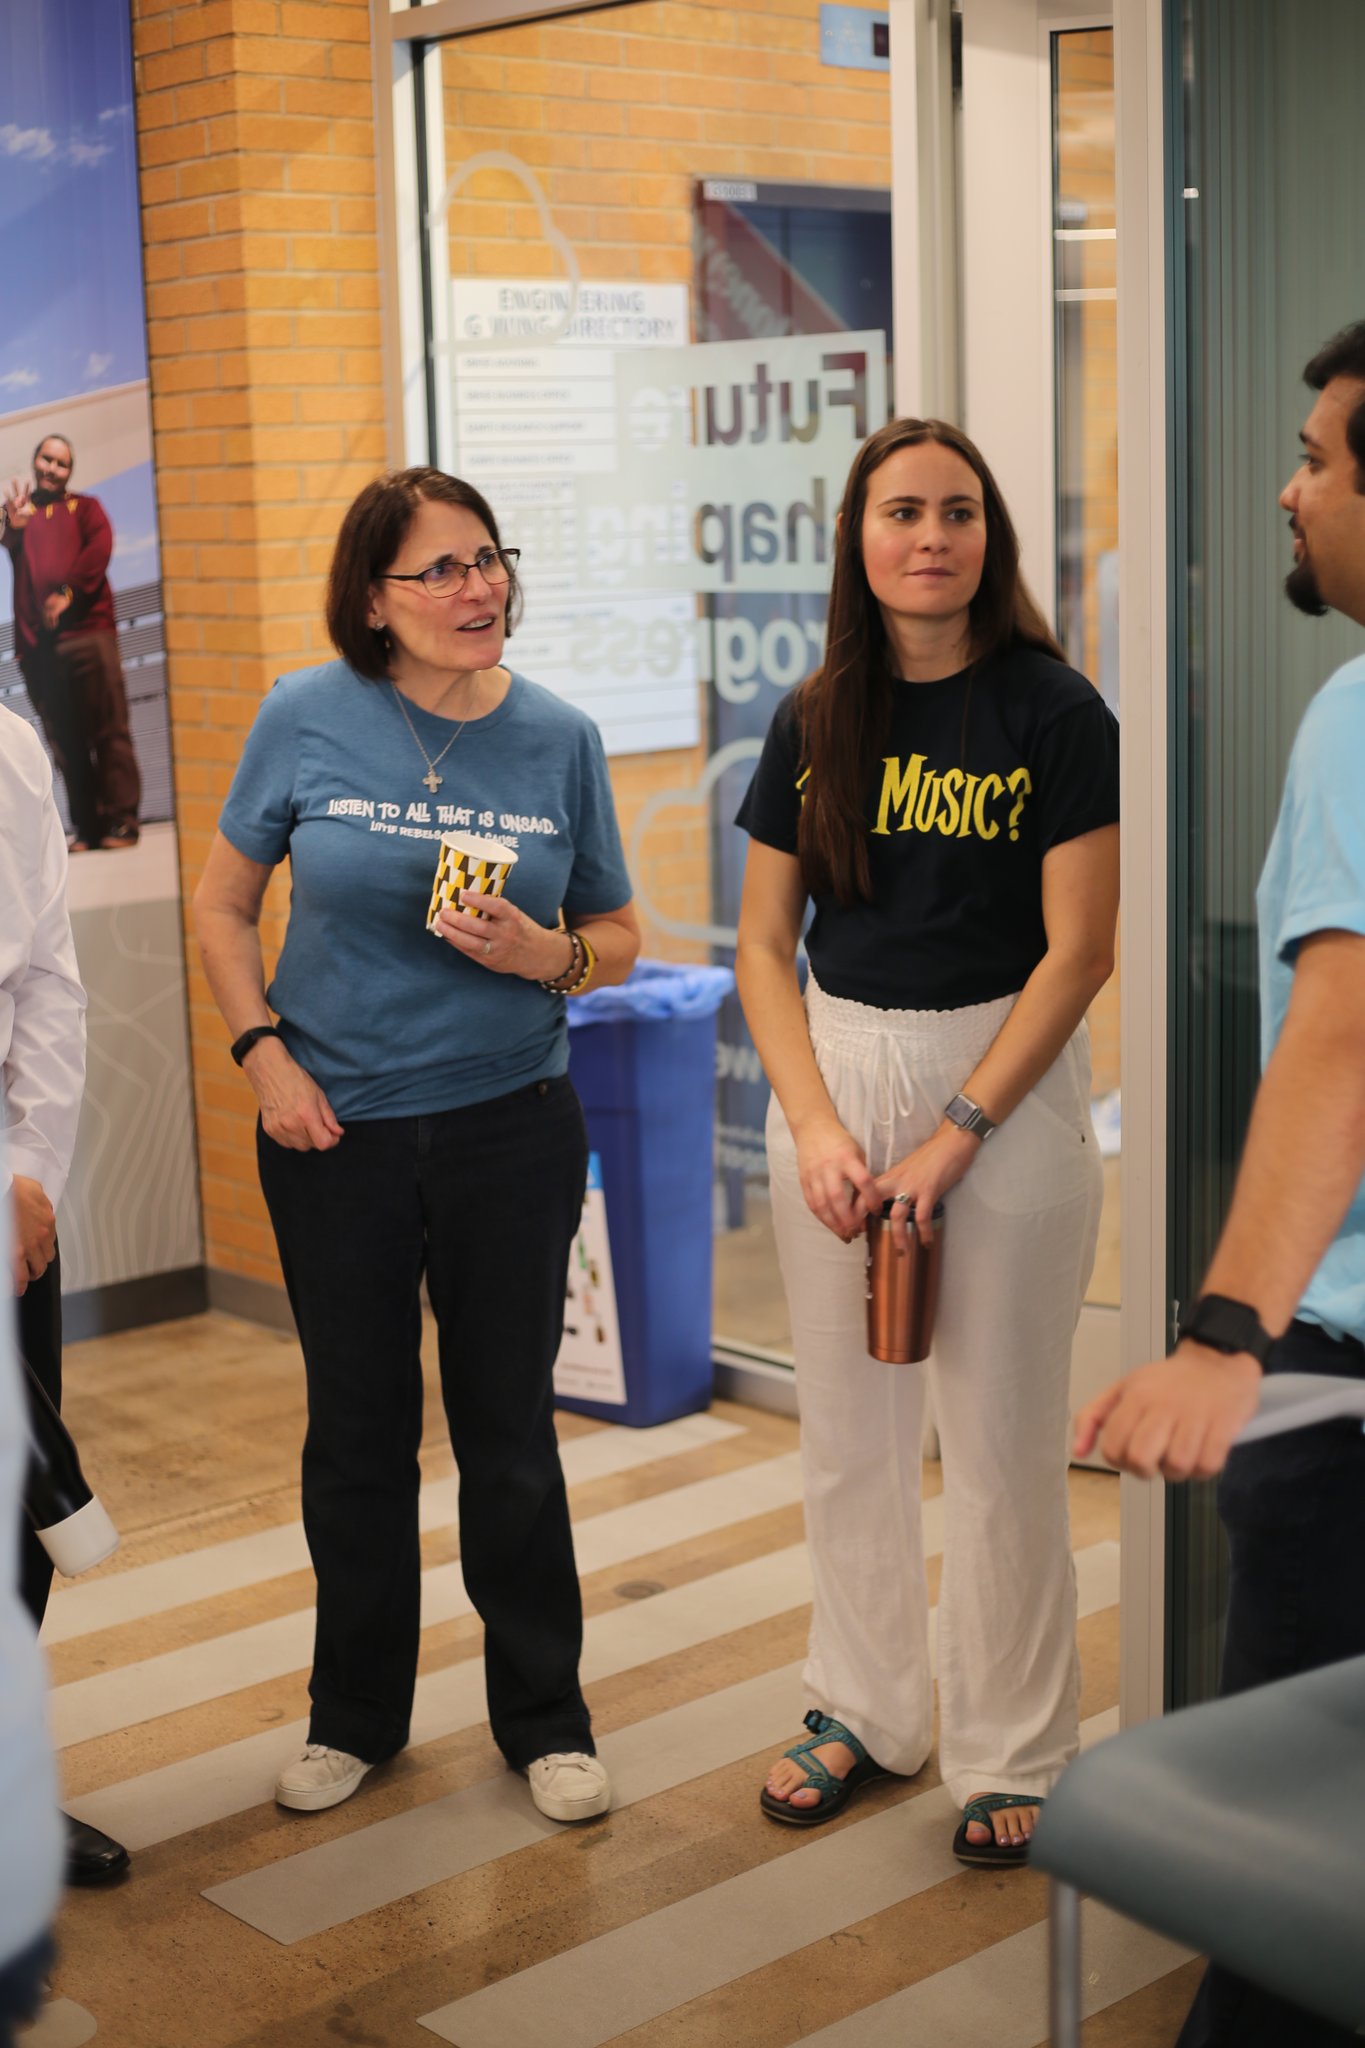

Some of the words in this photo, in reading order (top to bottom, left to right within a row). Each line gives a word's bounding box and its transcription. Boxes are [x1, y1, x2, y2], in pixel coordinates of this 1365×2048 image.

[499, 287, 646, 314] ENGINERING
[327, 798, 375, 818] LISTEN
[377, 802, 401, 820] TO
[405, 802, 431, 823] ALL
[436, 805, 475, 827] THAT
[478, 811, 494, 828] IS
[499, 813, 559, 835] UNSAID.
